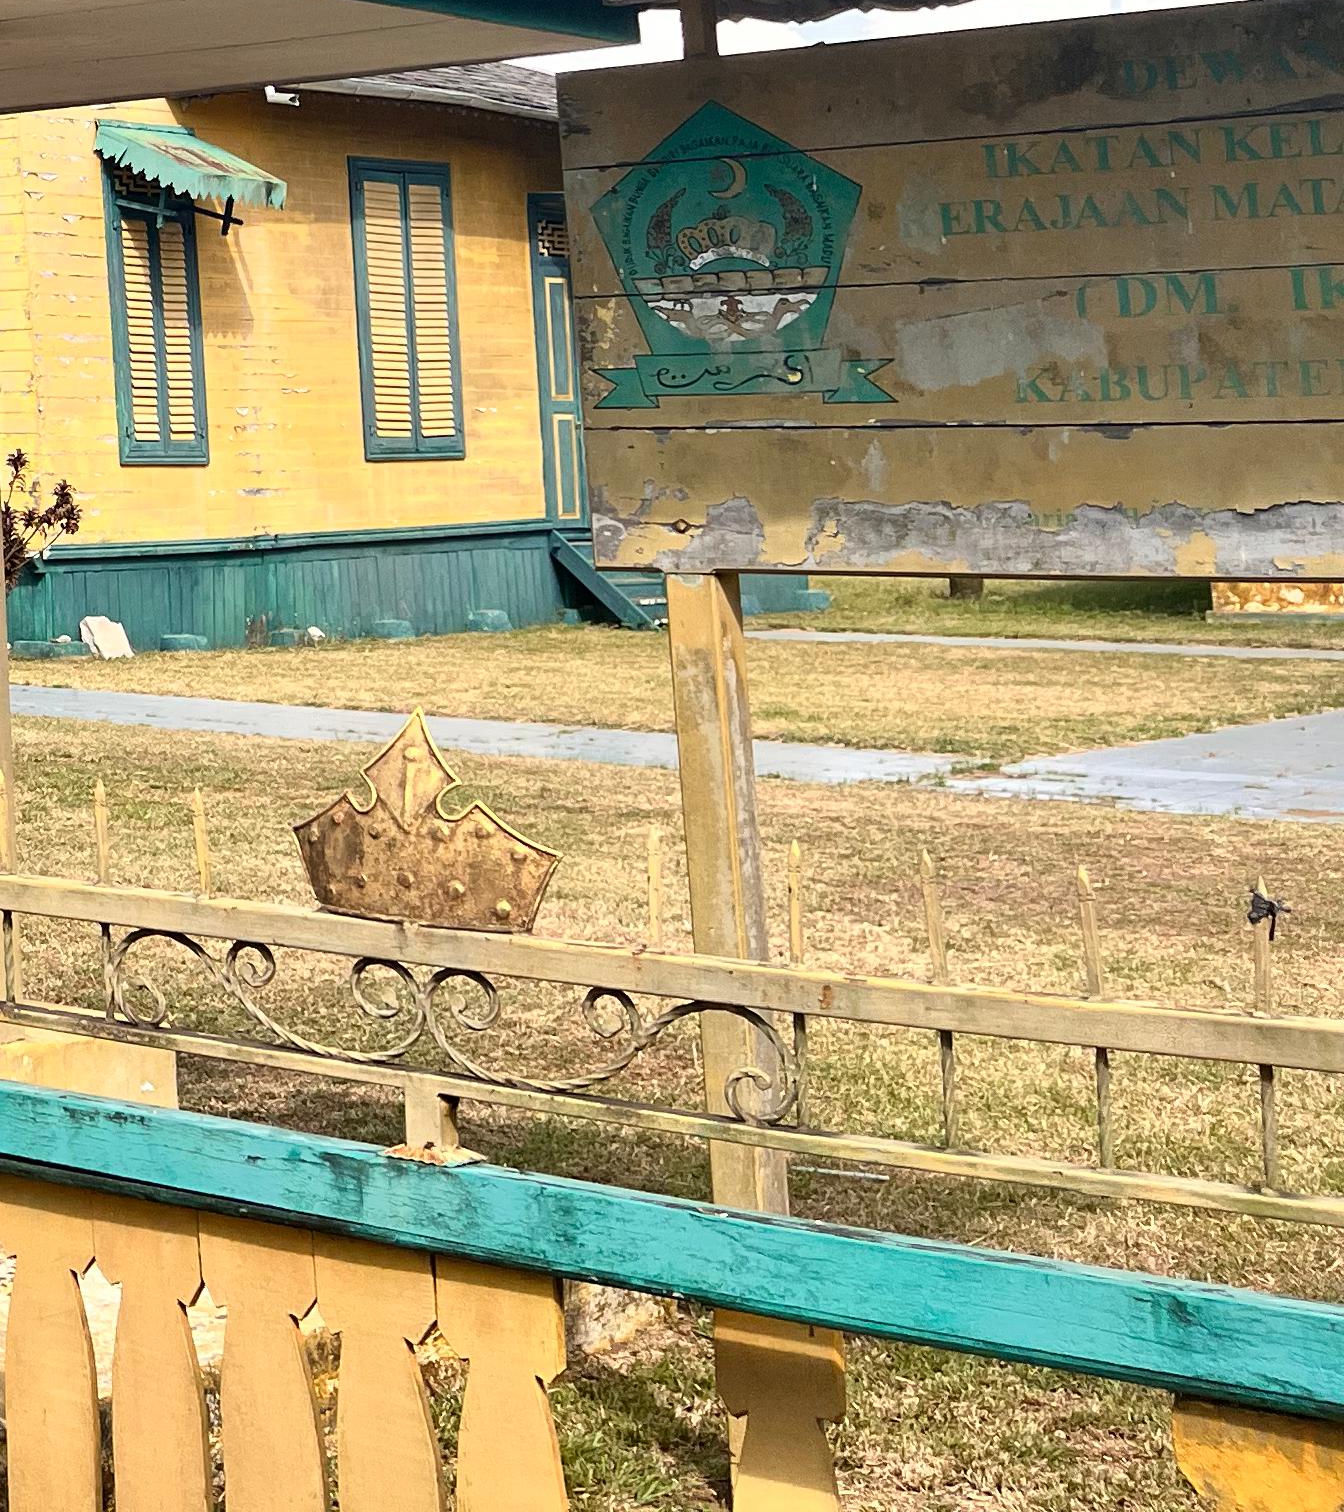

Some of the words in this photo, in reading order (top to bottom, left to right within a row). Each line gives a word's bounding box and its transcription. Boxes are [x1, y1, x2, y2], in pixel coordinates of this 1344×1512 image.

[982, 128, 1201, 178] IKATAN
[934, 186, 1191, 238] ERAJAAN
[1210, 178, 1344, 221] MAT
[1015, 358, 1344, 405] KABUPATE
